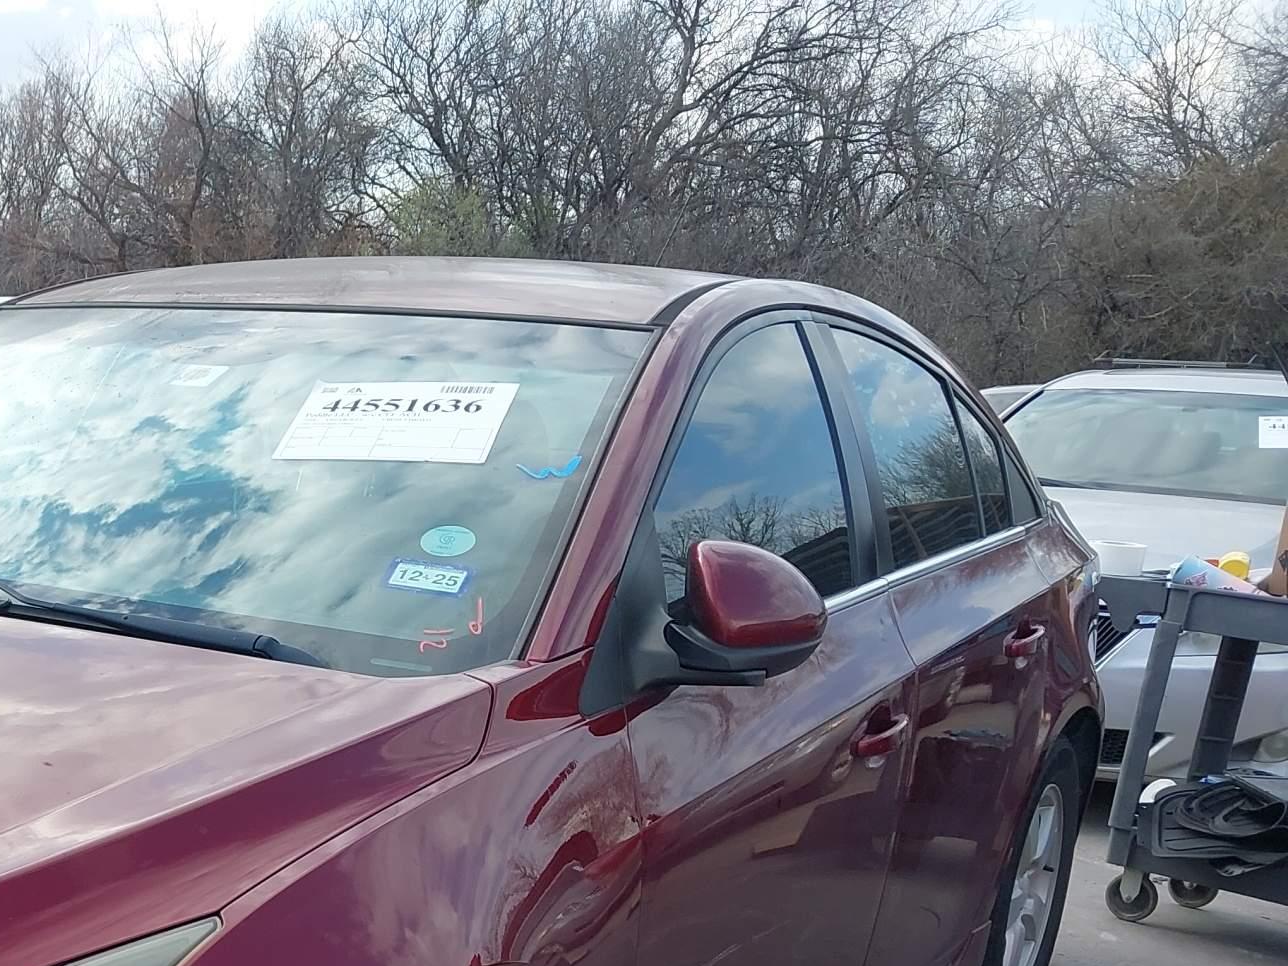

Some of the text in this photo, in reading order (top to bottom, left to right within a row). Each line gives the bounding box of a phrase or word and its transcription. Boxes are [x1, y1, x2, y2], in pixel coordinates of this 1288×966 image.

[321, 398, 488, 414] 44551636
[398, 568, 461, 587] 12 25
